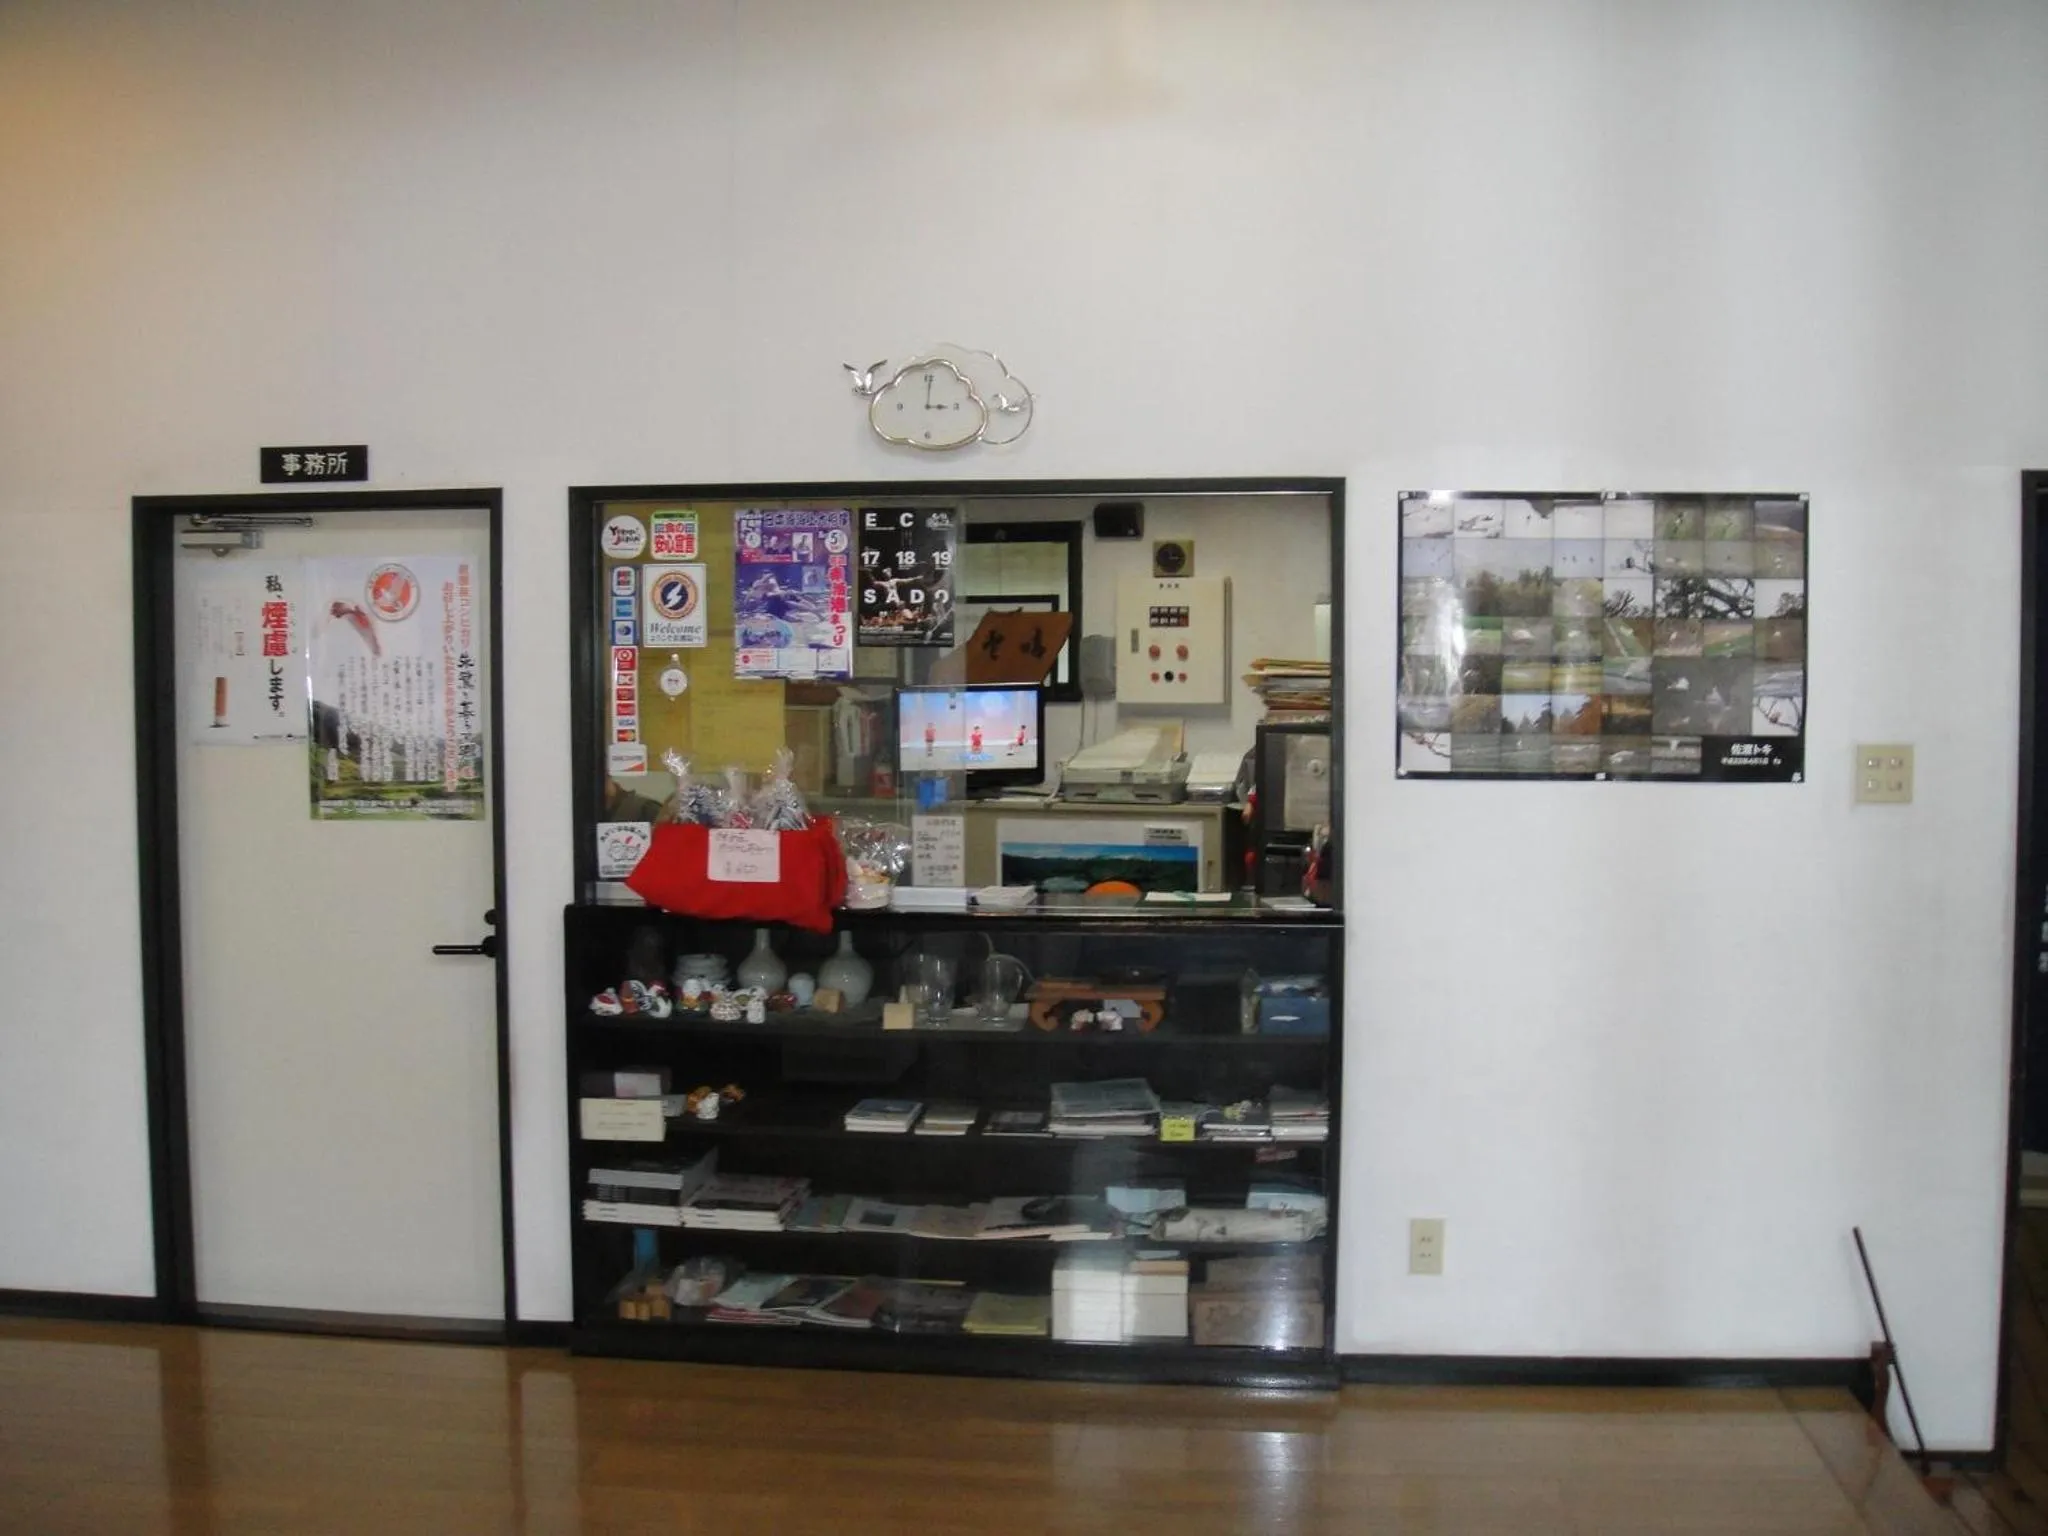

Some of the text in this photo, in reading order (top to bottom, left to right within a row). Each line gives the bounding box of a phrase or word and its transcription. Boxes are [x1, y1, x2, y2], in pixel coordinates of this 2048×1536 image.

[281, 452, 348, 476] 事務所
[865, 513, 877, 527] E
[900, 513, 914, 527] C
[861, 551, 880, 565] 17
[896, 551, 916, 565] 18
[932, 551, 952, 565] 19
[650, 622, 702, 634] Welcome
